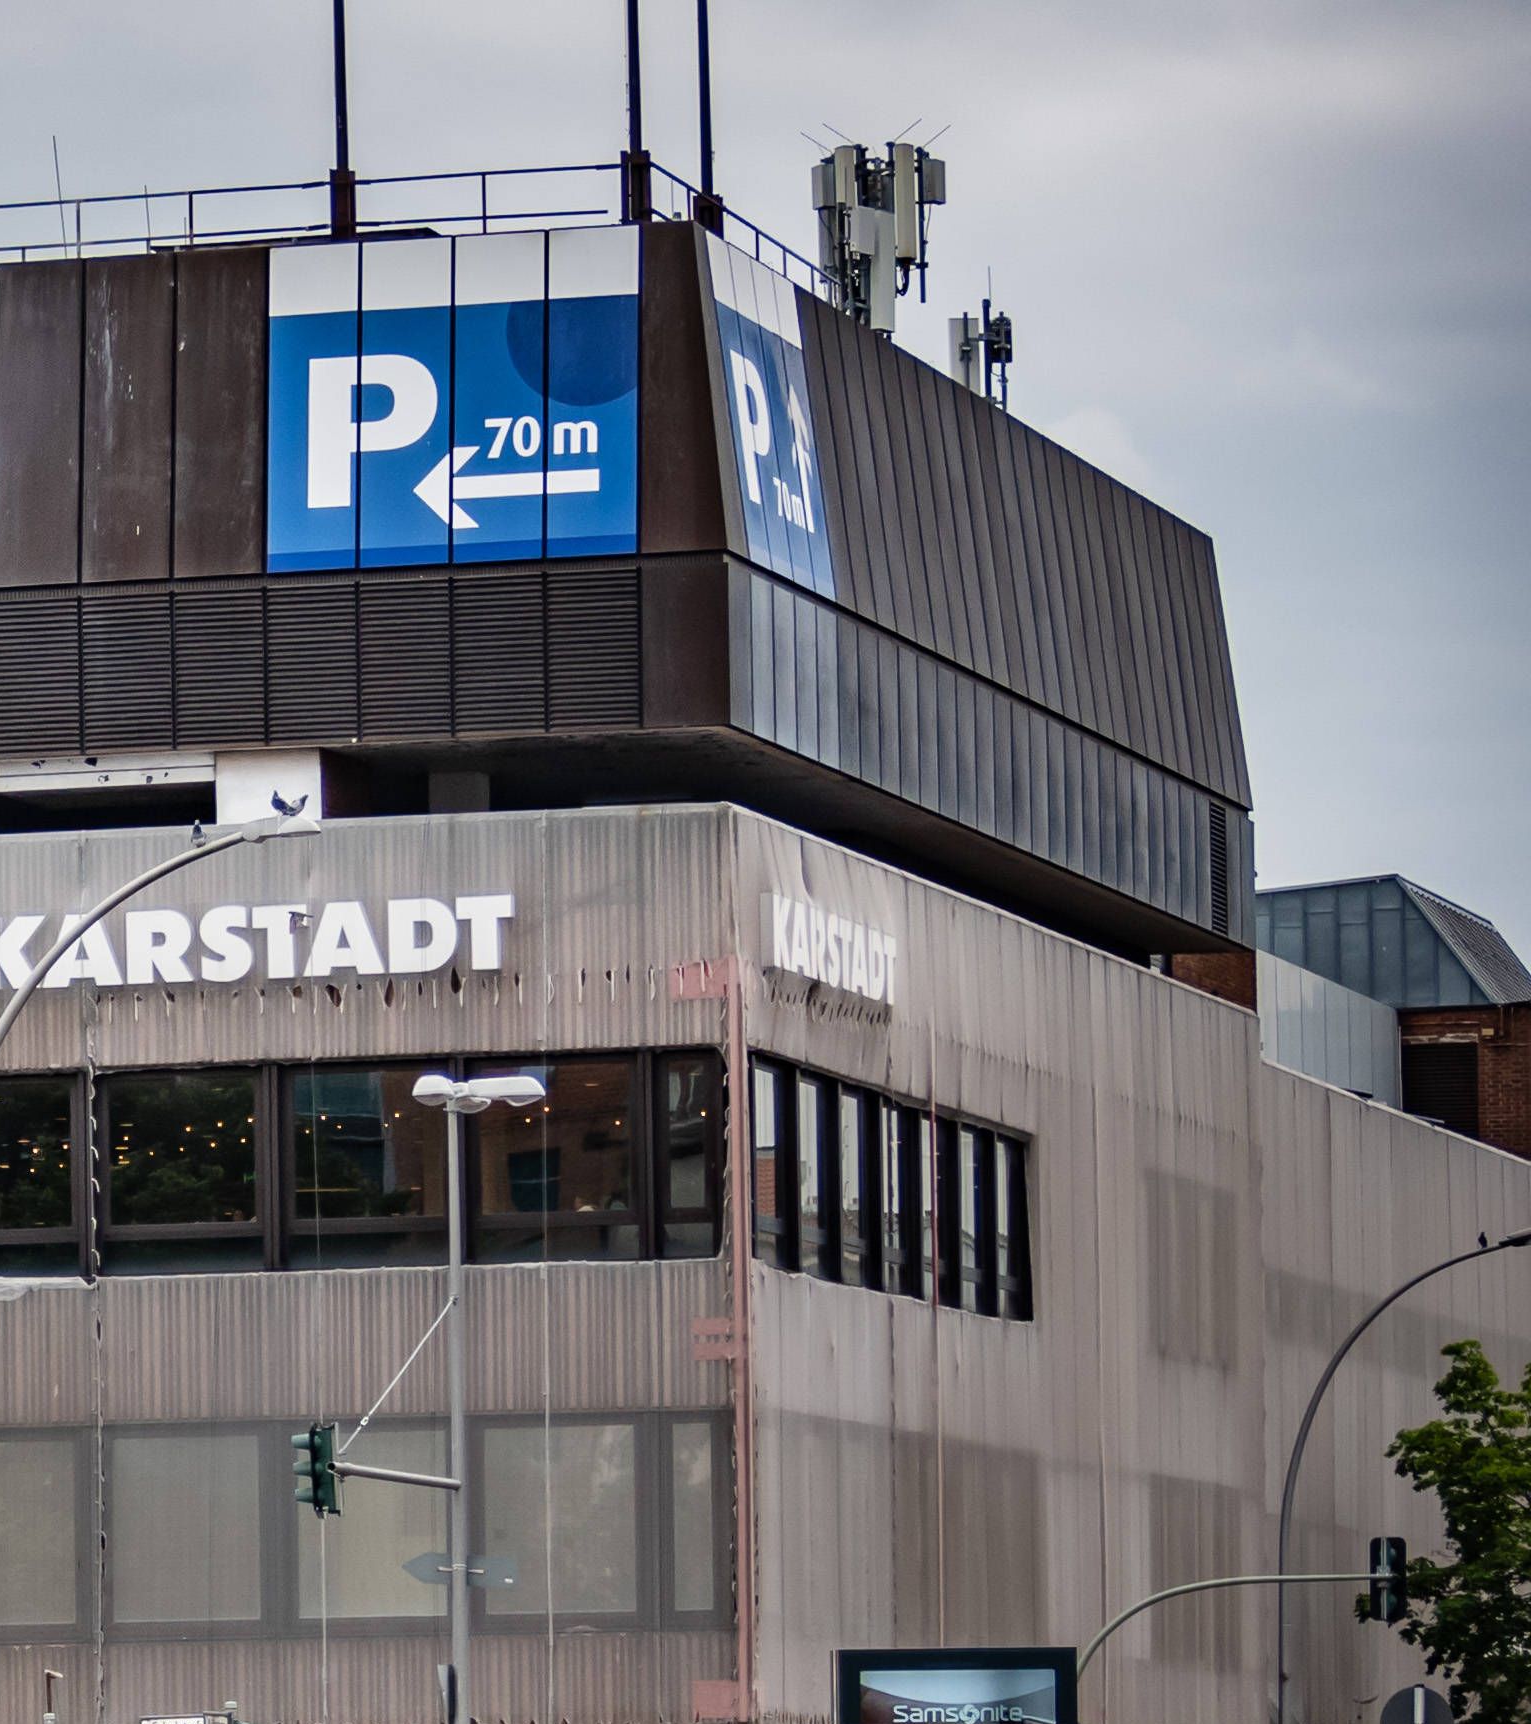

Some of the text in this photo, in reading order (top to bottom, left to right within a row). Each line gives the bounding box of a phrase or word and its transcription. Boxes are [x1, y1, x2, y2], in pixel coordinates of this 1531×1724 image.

[307, 354, 437, 509] P
[484, 416, 598, 459] 70 m
[730, 349, 771, 505] P
[773, 893, 897, 1006] KARSTADT
